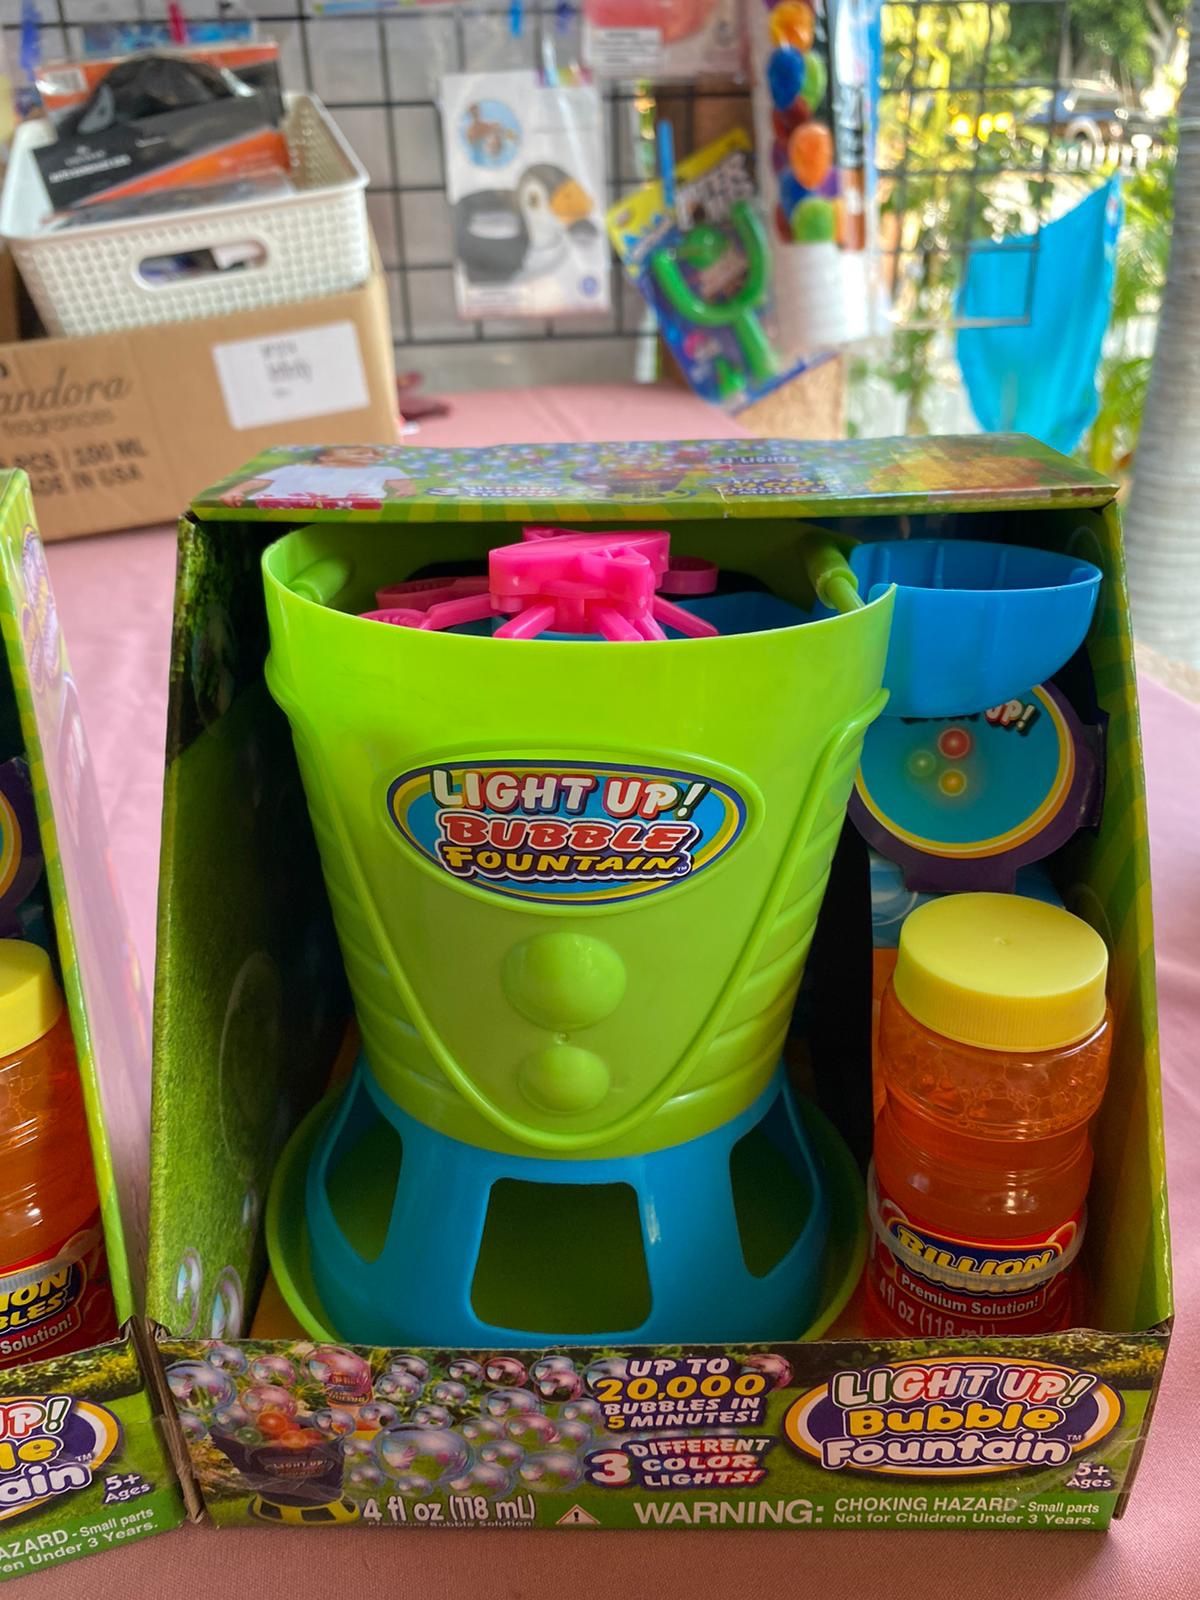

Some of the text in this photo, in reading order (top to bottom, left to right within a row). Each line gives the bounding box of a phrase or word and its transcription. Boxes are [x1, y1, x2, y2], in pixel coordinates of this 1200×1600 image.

[431, 769, 706, 818] LIGHT UP!
[441, 816, 692, 851] BUBBLE
[442, 846, 679, 872] FOUNTAIN
[898, 1226, 1052, 1278] BILLION
[901, 1275, 968, 1313] Premium
[970, 1295, 1039, 1316] Solution!
[899, 1300, 916, 1326] oz
[0, 1313, 73, 1355] Solution!
[629, 1358, 730, 1377] UP TO
[597, 1374, 766, 1402] 20,000
[836, 1367, 1095, 1406] LIGHT UP!
[604, 1397, 761, 1416] BUBBLES IN
[608, 1410, 760, 1429] 5 MINUTES!
[848, 1402, 1060, 1437] Bubble
[628, 1438, 770, 1457] DIFFERENT
[825, 1432, 1070, 1467] Fountain
[591, 1452, 631, 1484] 3
[641, 1454, 758, 1472] COLOR
[1076, 1463, 1109, 1478] 5+
[106, 1474, 141, 1491] 5+
[644, 1469, 766, 1487] LIGHTS!
[1066, 1475, 1112, 1489] Ages
[104, 1483, 151, 1504] Ages
[834, 1497, 927, 1512] CHOKING
[933, 1497, 1017, 1512] HAZARD
[1028, 1502, 1064, 1513] Small
[1066, 1503, 1100, 1514] parts
[363, 1494, 536, 1521] 4 fl oz (118 mL)
[633, 1499, 825, 1524] WARNING:
[832, 1512, 1096, 1525] Not for Children Under 3 Years.
[80, 1518, 118, 1537] Small
[120, 1508, 155, 1526] parts
[479, 1520, 533, 1528] Solution
[29, 1543, 82, 1565] Under
[88, 1537, 99, 1548] 3
[103, 1522, 158, 1542] Years.
